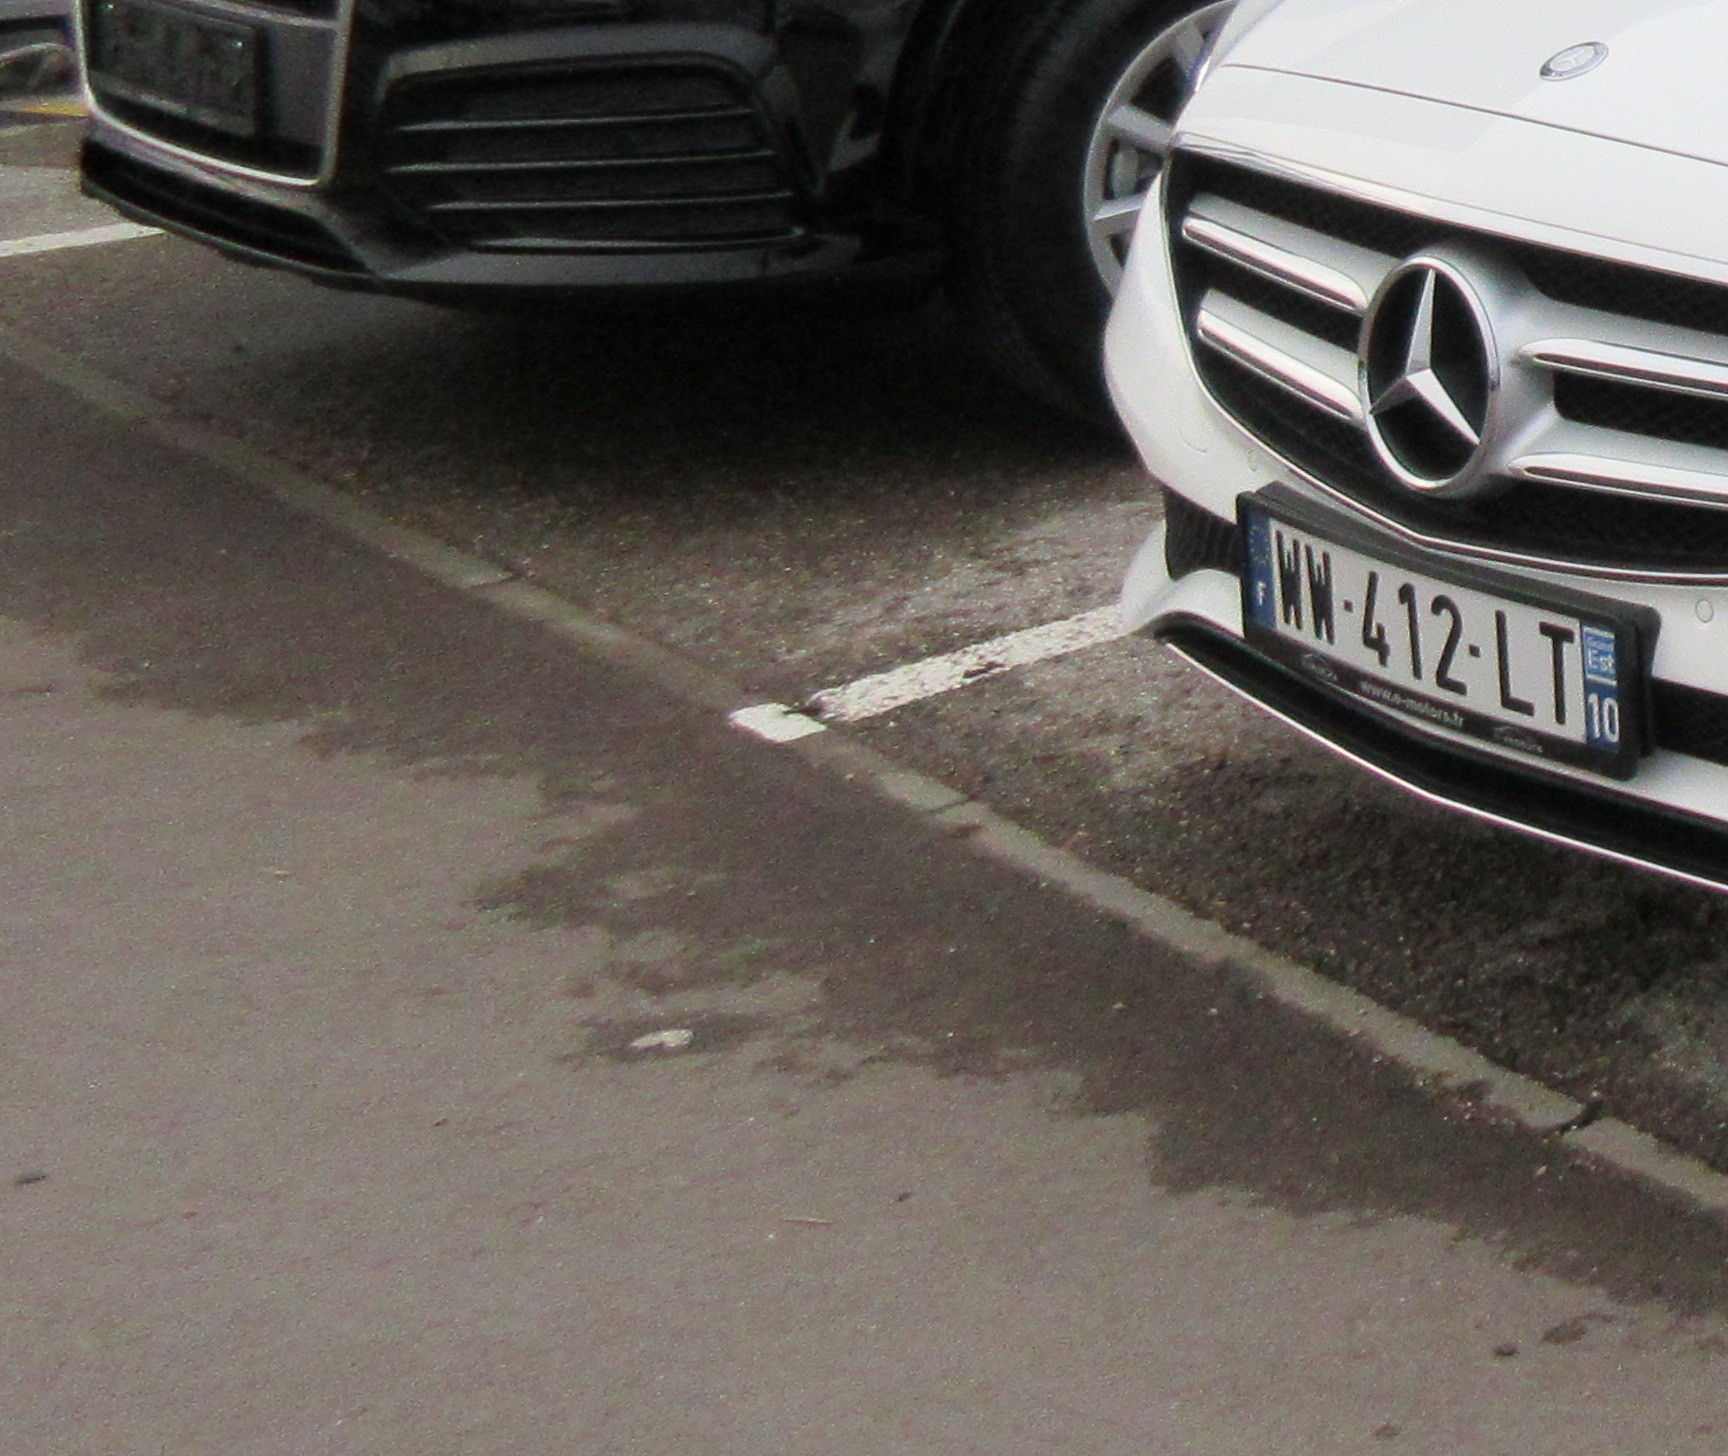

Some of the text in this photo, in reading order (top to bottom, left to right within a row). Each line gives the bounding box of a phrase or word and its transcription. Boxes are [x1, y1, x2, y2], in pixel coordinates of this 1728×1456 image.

[1256, 580, 1267, 606] F
[1587, 649, 1616, 674] Est
[1587, 692, 1620, 743] 10
